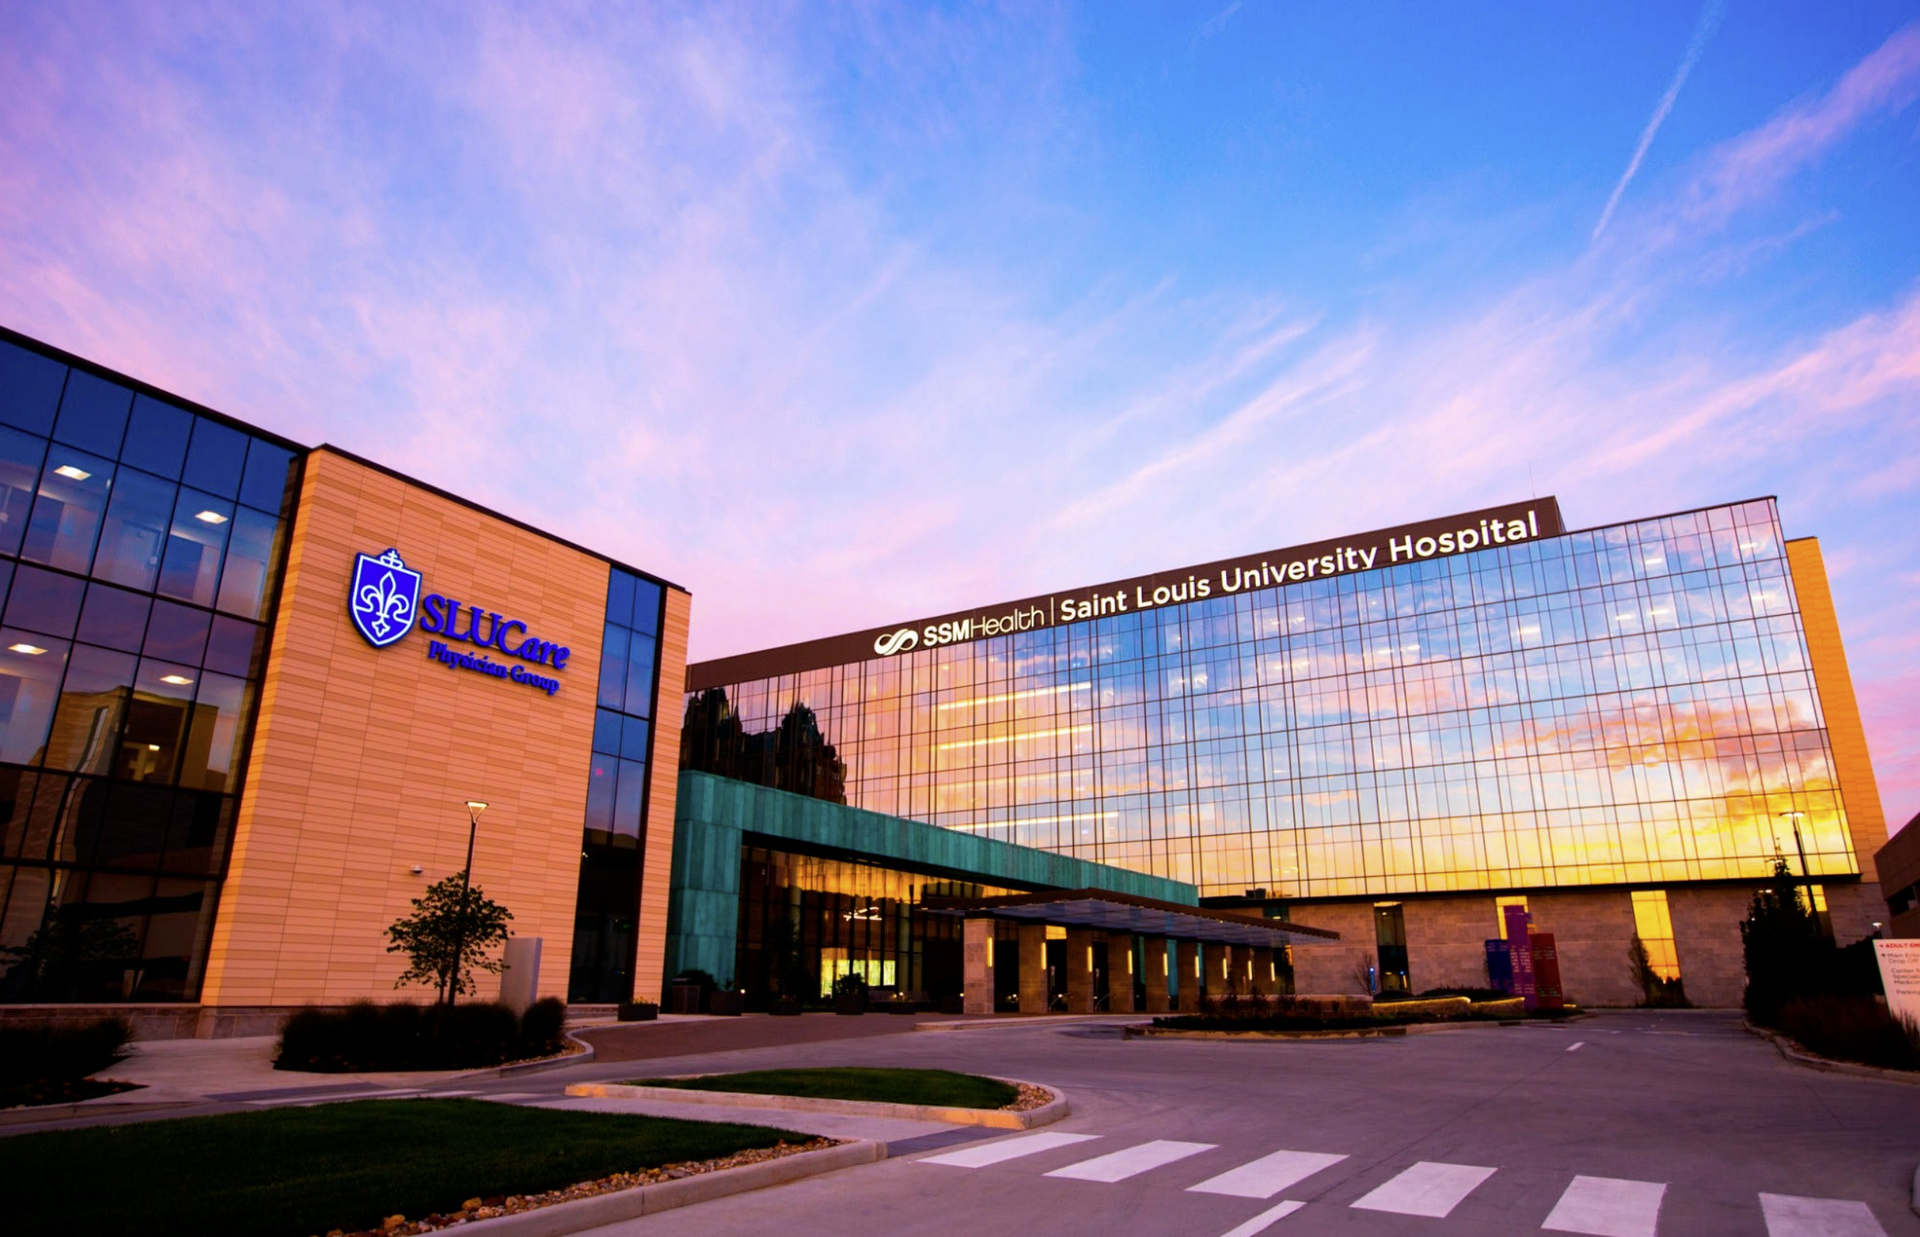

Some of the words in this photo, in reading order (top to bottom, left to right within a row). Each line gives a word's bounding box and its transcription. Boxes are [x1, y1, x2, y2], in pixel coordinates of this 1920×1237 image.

[1060, 590, 1127, 621] Saint
[1137, 576, 1211, 608] Louis
[1221, 546, 1377, 592] University
[1389, 510, 1538, 562] Hospital
[420, 594, 570, 670] SLUCare
[428, 640, 508, 679] Physician
[510, 665, 560, 695] Group
